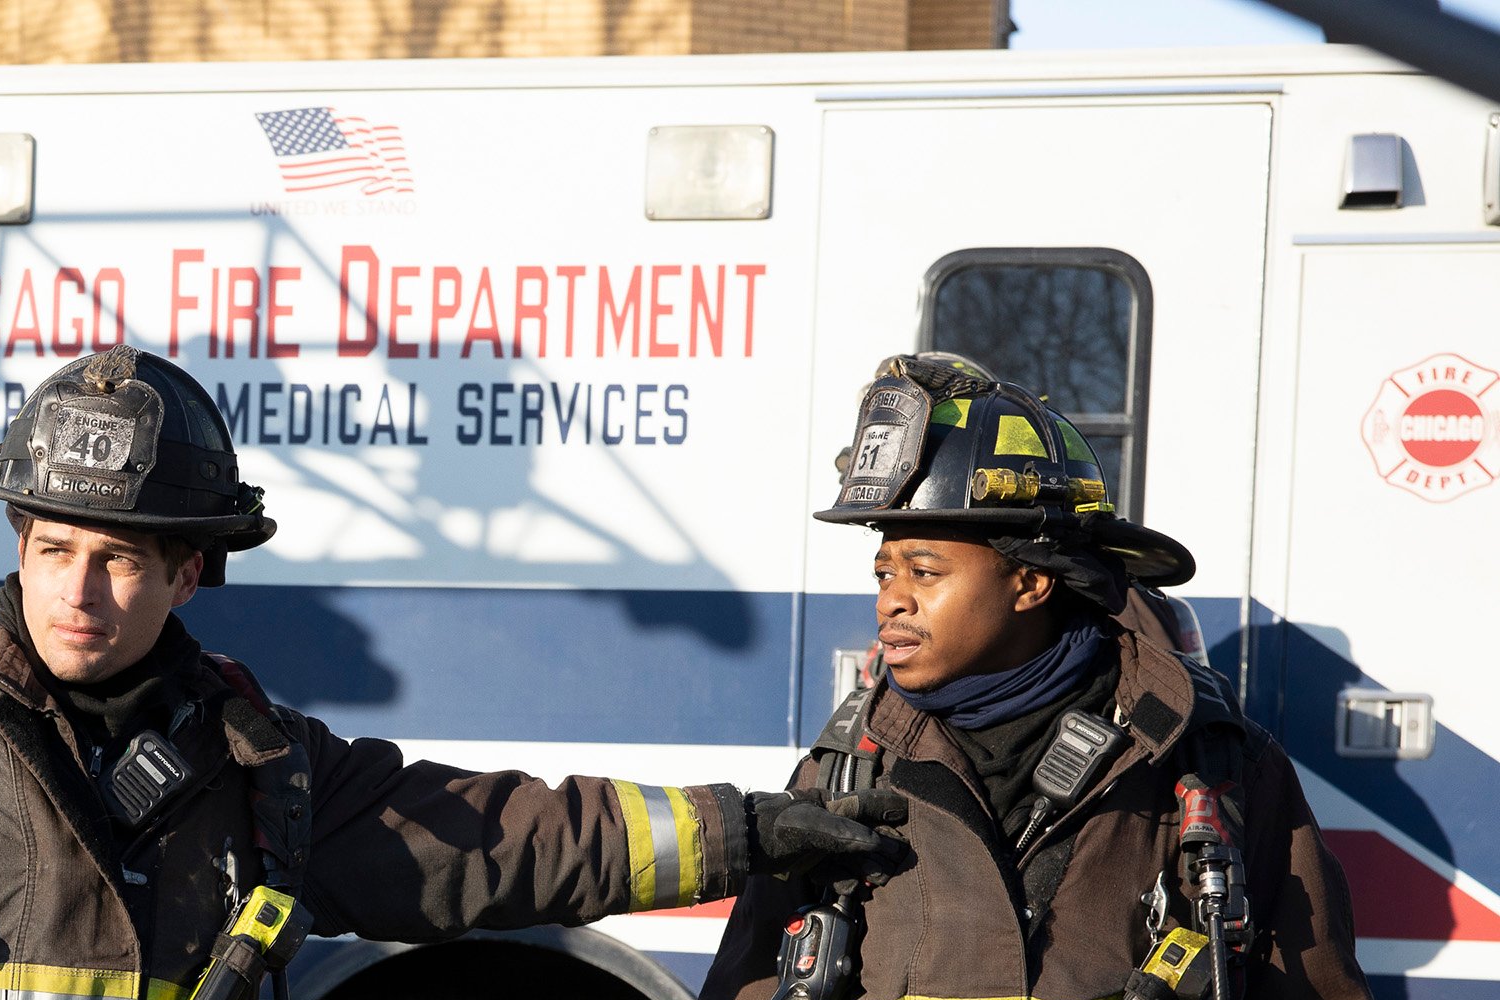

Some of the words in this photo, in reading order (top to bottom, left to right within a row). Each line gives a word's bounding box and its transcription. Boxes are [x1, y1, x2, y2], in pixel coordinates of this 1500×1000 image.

[321, 199, 351, 215] WE
[356, 199, 417, 215] STAND
[1417, 367, 1473, 384] FIRE
[74, 416, 119, 431] ENGINE
[217, 382, 429, 445] MEDICAL
[457, 382, 690, 445] SERVICES
[1402, 414, 1484, 442] CHICAGO
[69, 432, 112, 463] 40
[857, 444, 880, 470] 51
[51, 476, 123, 498] CHICAGO
[1075, 724, 1103, 742] MOTOROLA
[153, 750, 180, 778] MOTOROLA
[1186, 825, 1215, 834] AIR-PAK
